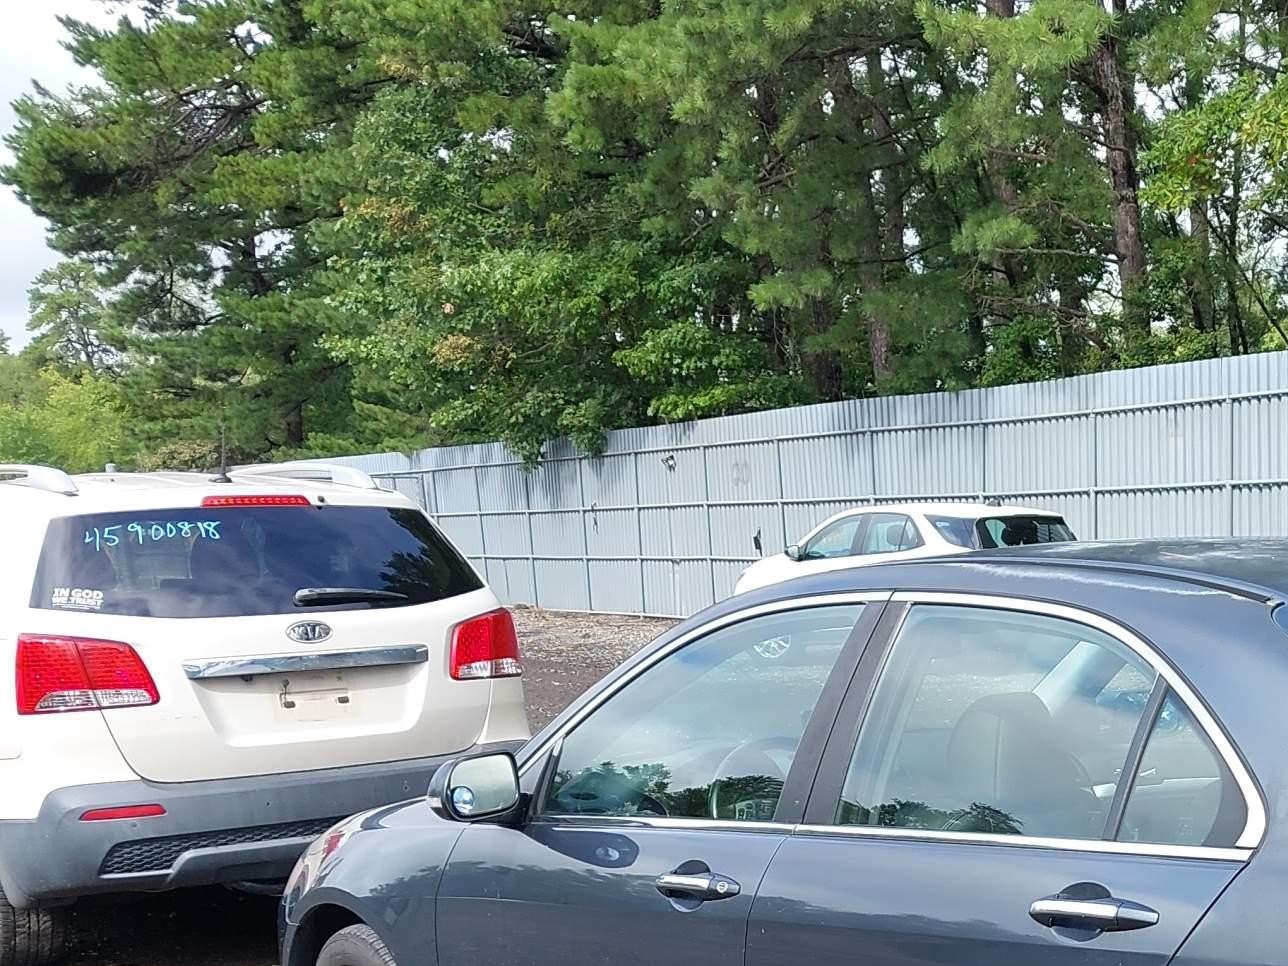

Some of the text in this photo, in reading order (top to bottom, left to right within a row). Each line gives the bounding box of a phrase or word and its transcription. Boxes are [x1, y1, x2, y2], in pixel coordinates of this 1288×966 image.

[84, 521, 221, 551] 45900818
[51, 596, 69, 604] WE
[70, 597, 104, 607] TRUST
[52, 588, 104, 600] IN GOD
[287, 622, 332, 642] KIA
